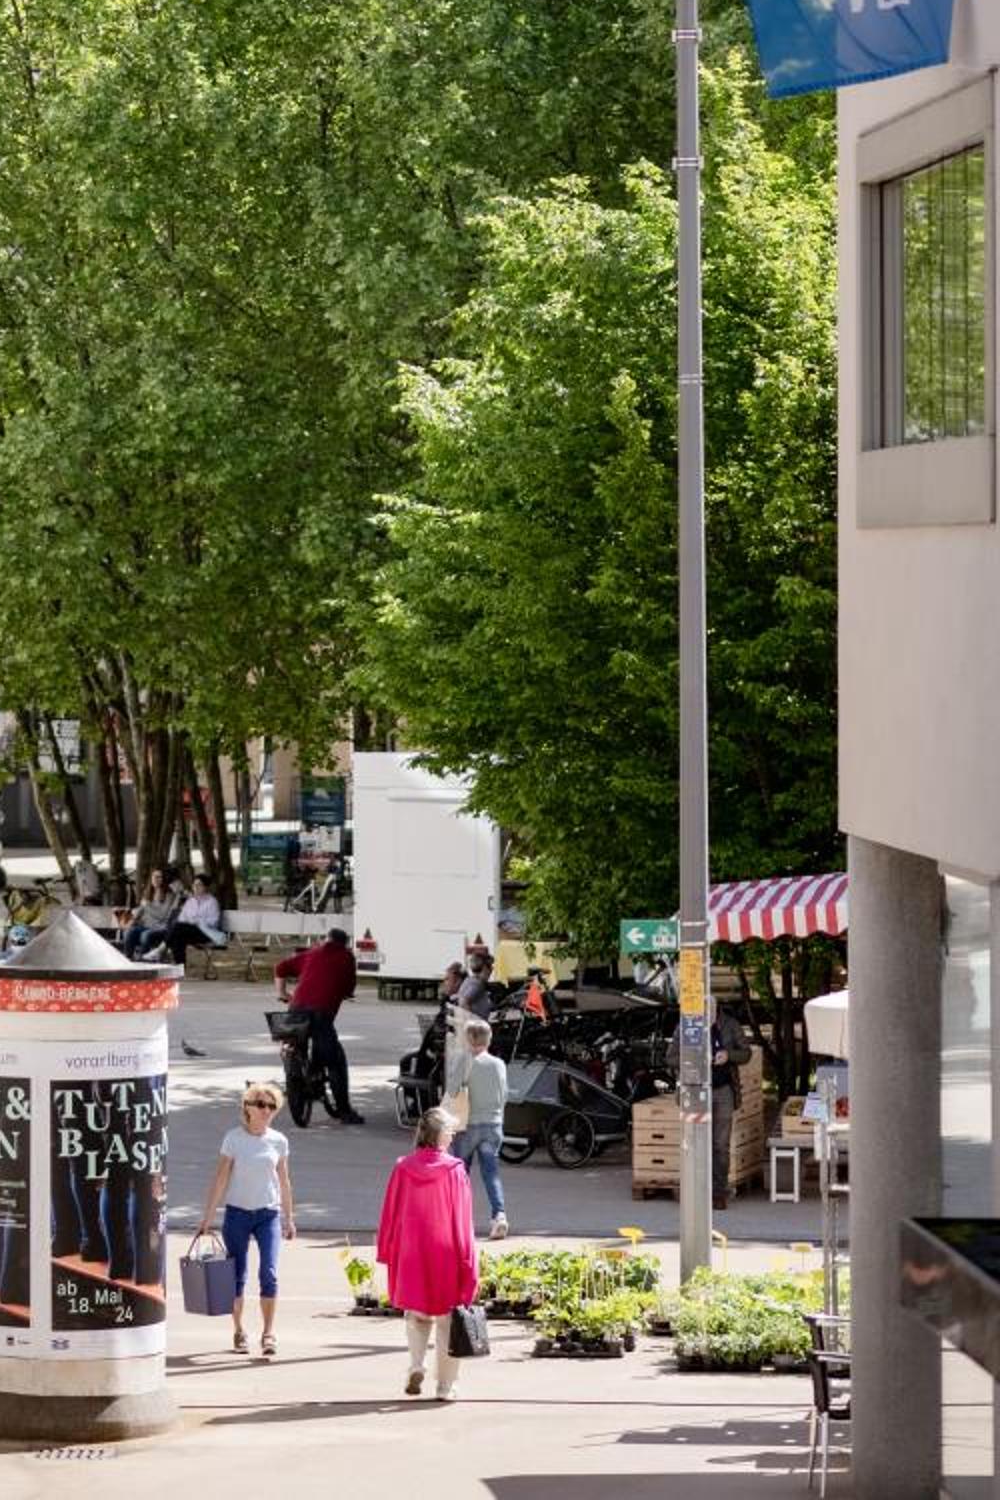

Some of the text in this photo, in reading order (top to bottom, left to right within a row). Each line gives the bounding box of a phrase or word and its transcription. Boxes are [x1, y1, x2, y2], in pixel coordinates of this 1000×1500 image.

[65, 1051, 139, 1070] vorarlberg
[56, 1280, 77, 1296] ab
[68, 1288, 123, 1314] 18. Mai
[115, 1306, 134, 1323] 24
